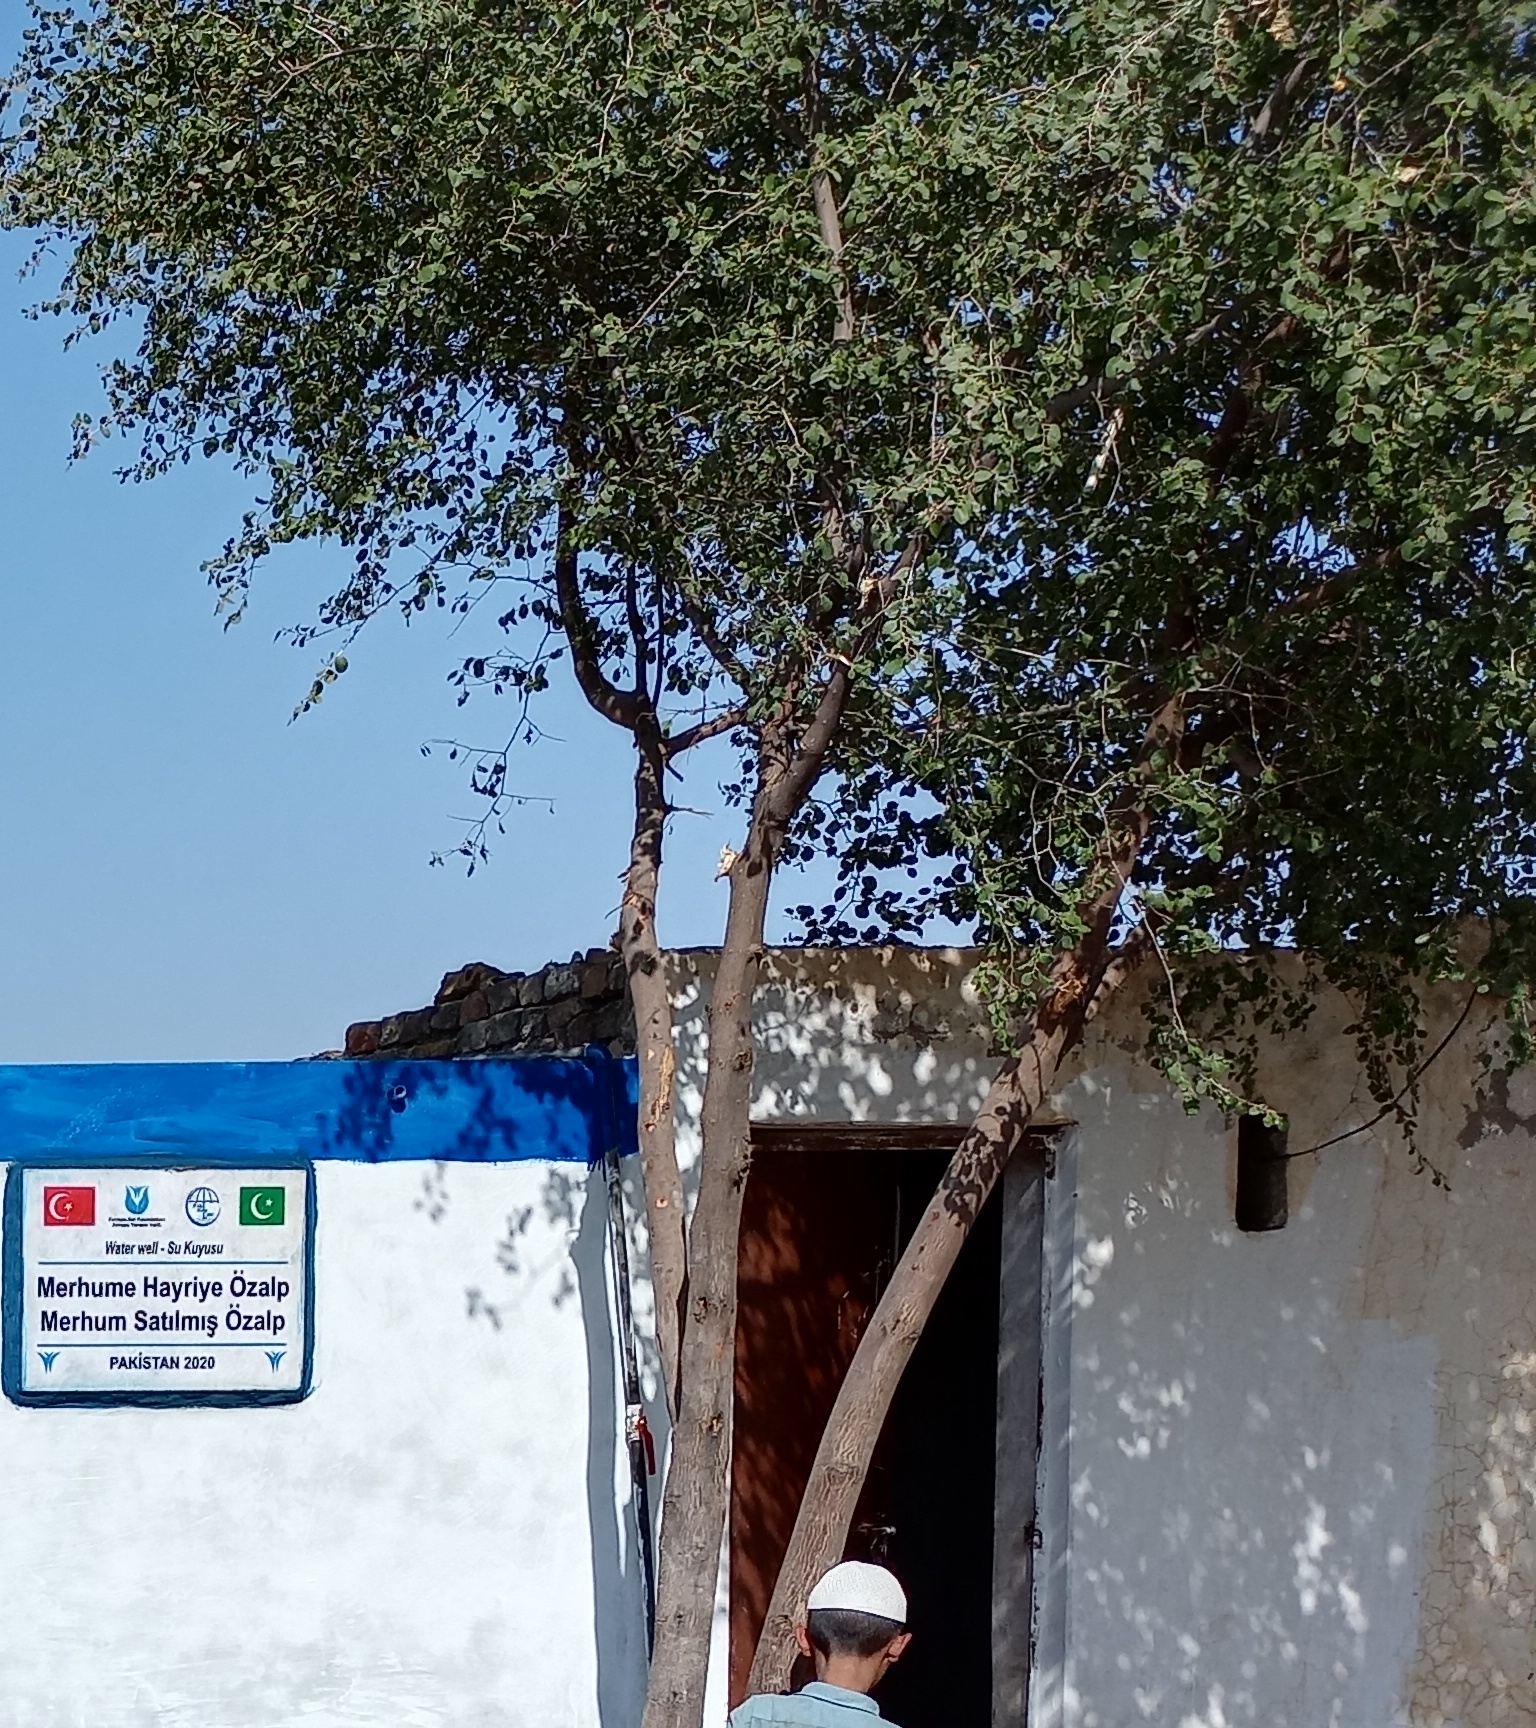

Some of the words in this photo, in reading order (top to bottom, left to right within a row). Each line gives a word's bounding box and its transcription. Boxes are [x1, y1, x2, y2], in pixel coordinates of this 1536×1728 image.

[105, 1240, 136, 1255] Water
[137, 1240, 159, 1255] well
[167, 1240, 182, 1255] Su
[183, 1240, 224, 1258] Kuyusu
[37, 1276, 137, 1298] Merhume
[143, 1275, 223, 1303] Hayriye
[229, 1270, 290, 1303] Özalp
[40, 1310, 127, 1332] Merhum
[133, 1309, 219, 1338] Satılmış
[225, 1304, 286, 1335] Özalp
[109, 1351, 180, 1370] PAKİSTAN
[183, 1356, 216, 1370] 2020
